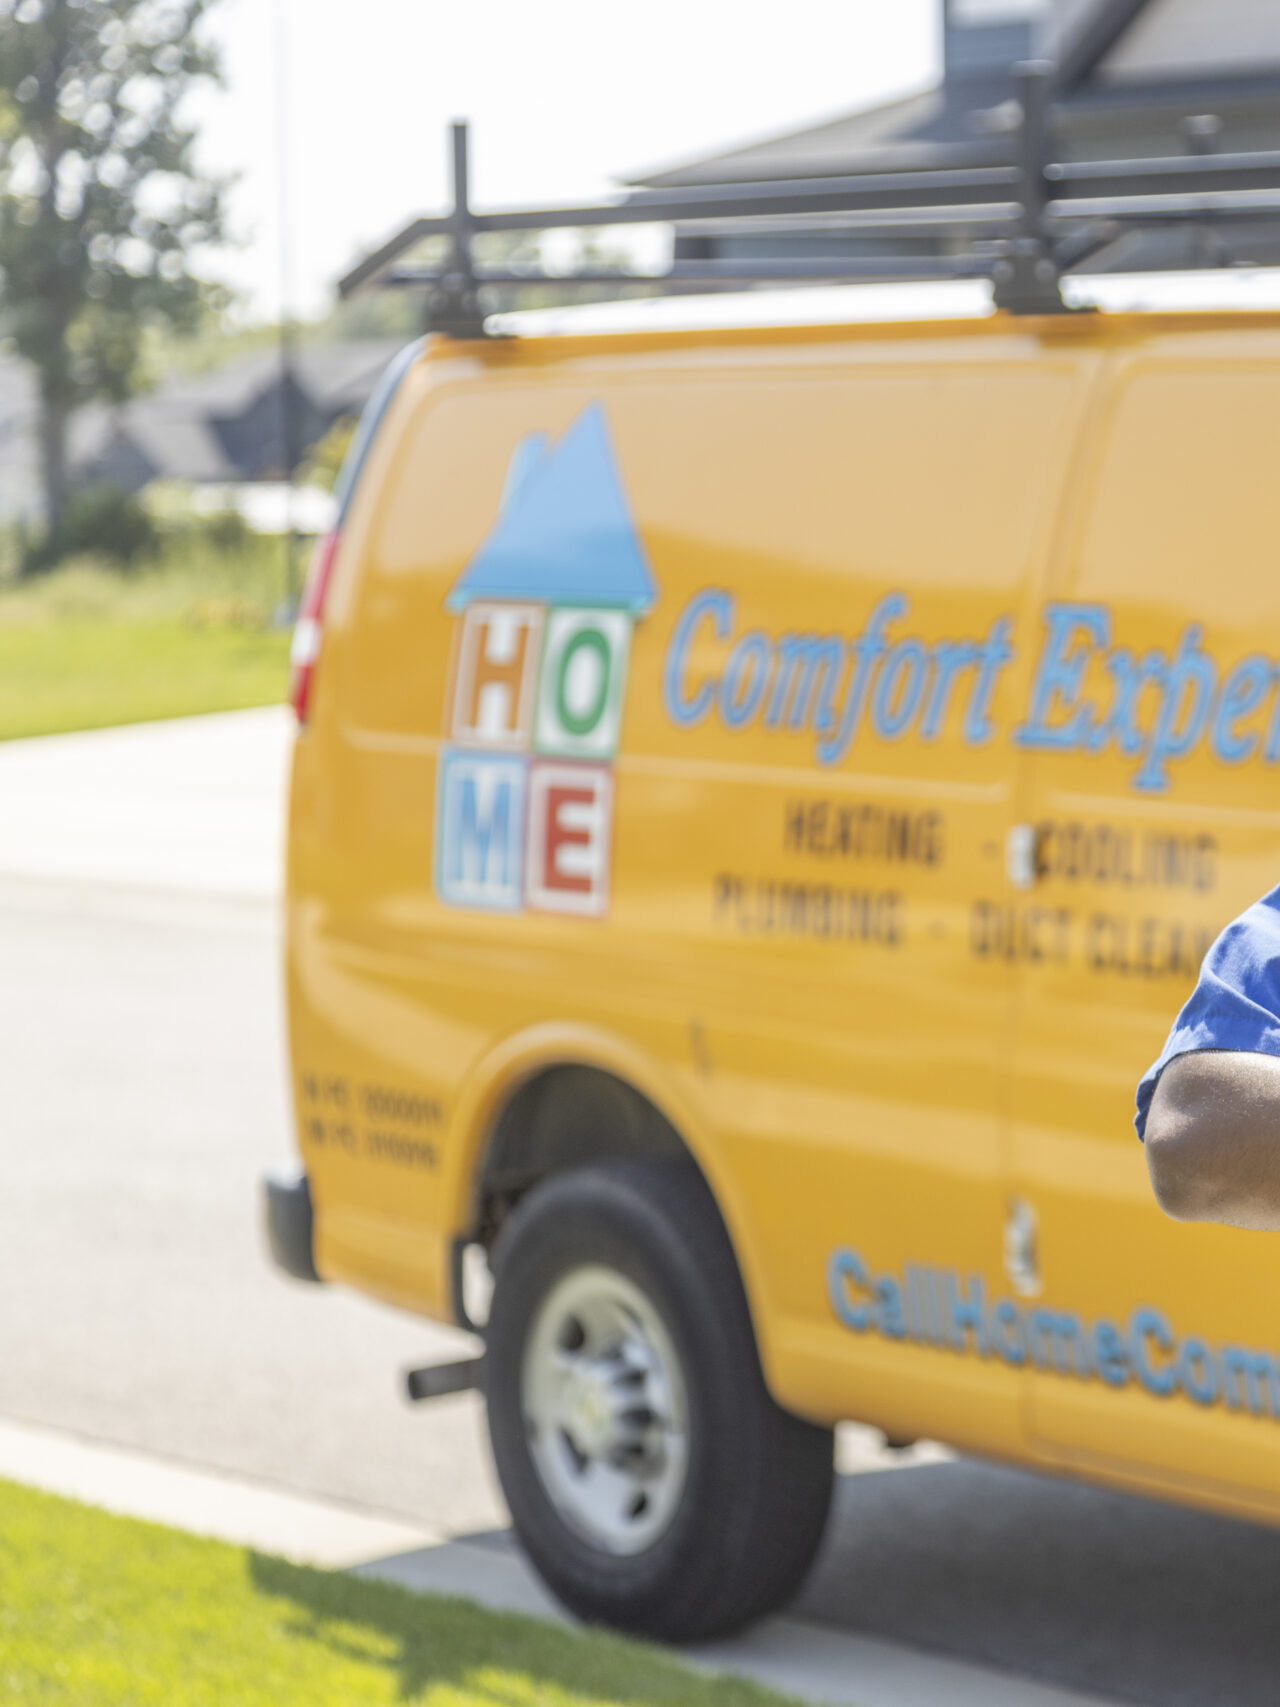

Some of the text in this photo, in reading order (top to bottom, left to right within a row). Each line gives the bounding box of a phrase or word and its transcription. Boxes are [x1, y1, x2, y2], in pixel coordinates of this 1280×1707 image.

[663, 588, 1014, 767] Comfort
[783, 796, 1217, 893] HEATING COOLING
[712, 871, 903, 949] PLUMBING
[969, 898, 1071, 968] DUCT
